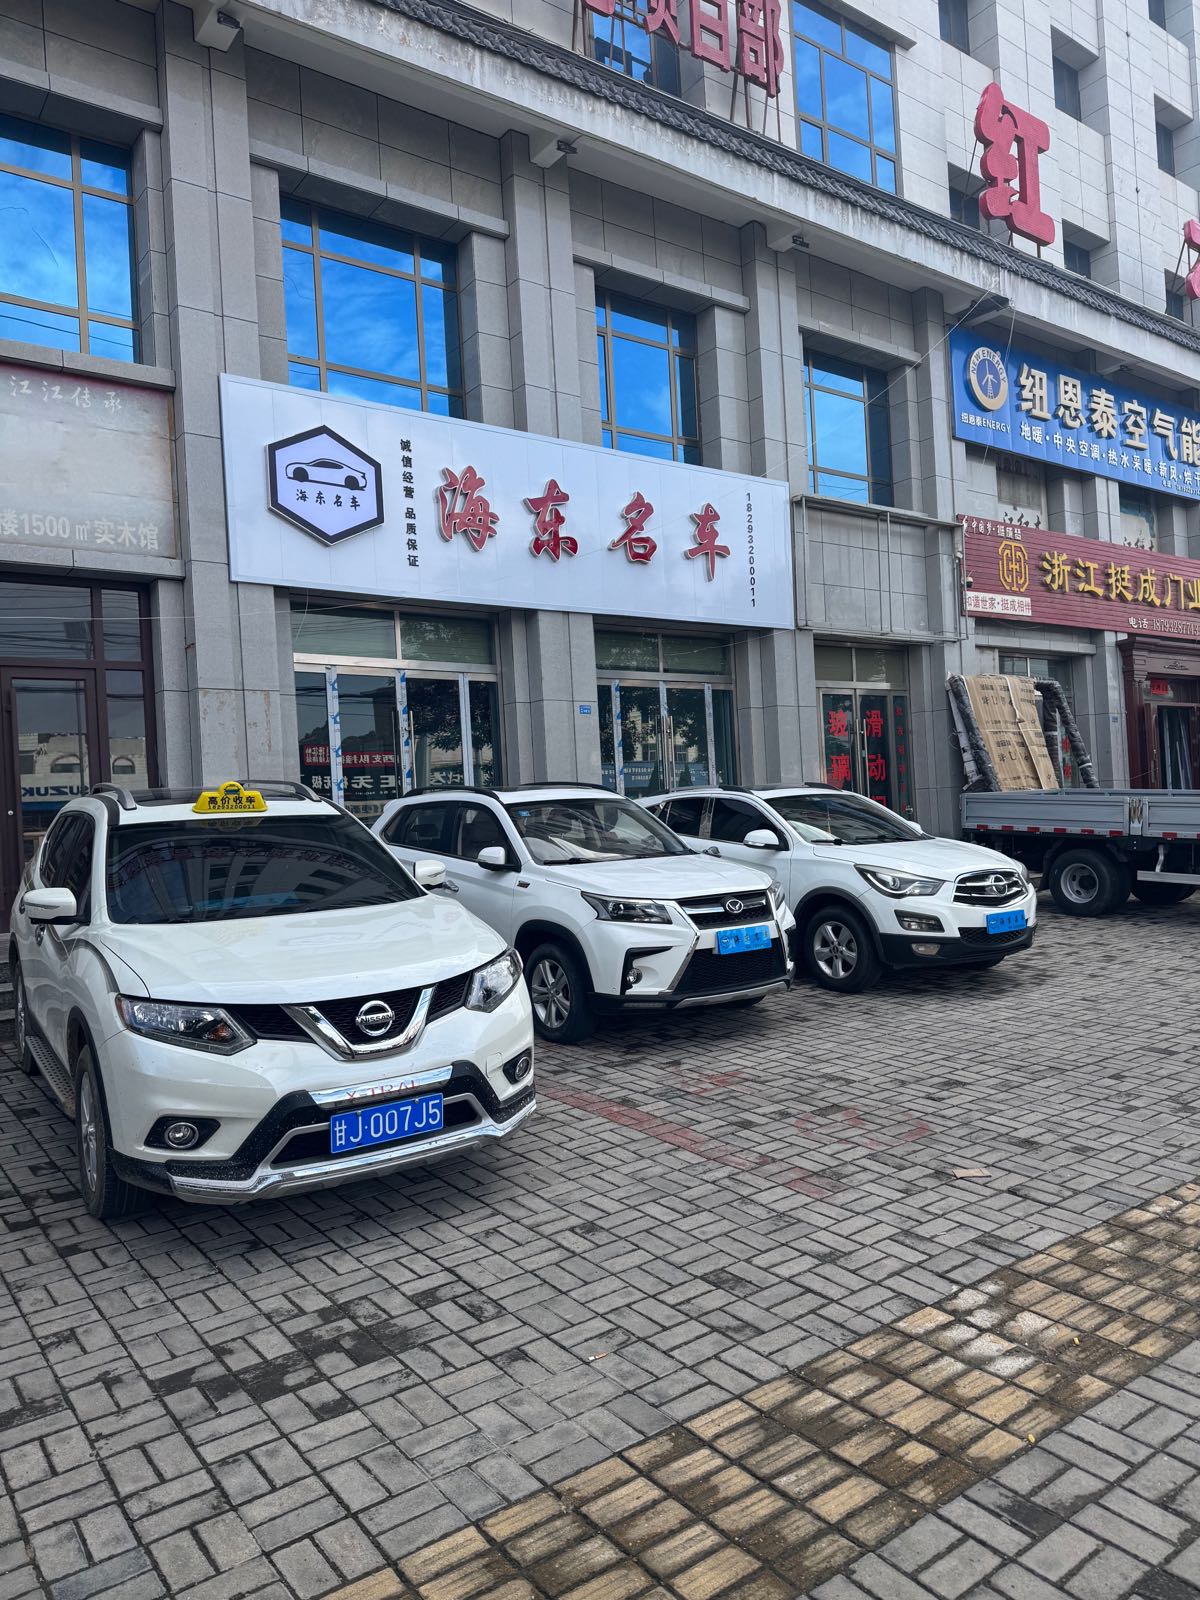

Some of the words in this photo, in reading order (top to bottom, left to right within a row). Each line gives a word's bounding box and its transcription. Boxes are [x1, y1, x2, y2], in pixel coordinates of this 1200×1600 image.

[1018, 362, 1200, 467] 纽恩泰空气能
[400, 439, 415, 499] 诚信经营
[295, 489, 360, 511] 海东名车
[434, 465, 731, 582] 海东名车
[405, 507, 419, 567] 品质保证
[745, 492, 756, 608] 18293200011
[1128, 617, 1148, 628] 电话
[208, 796, 256, 805] 高价收车
[360, 1013, 393, 1024] NISSAN
